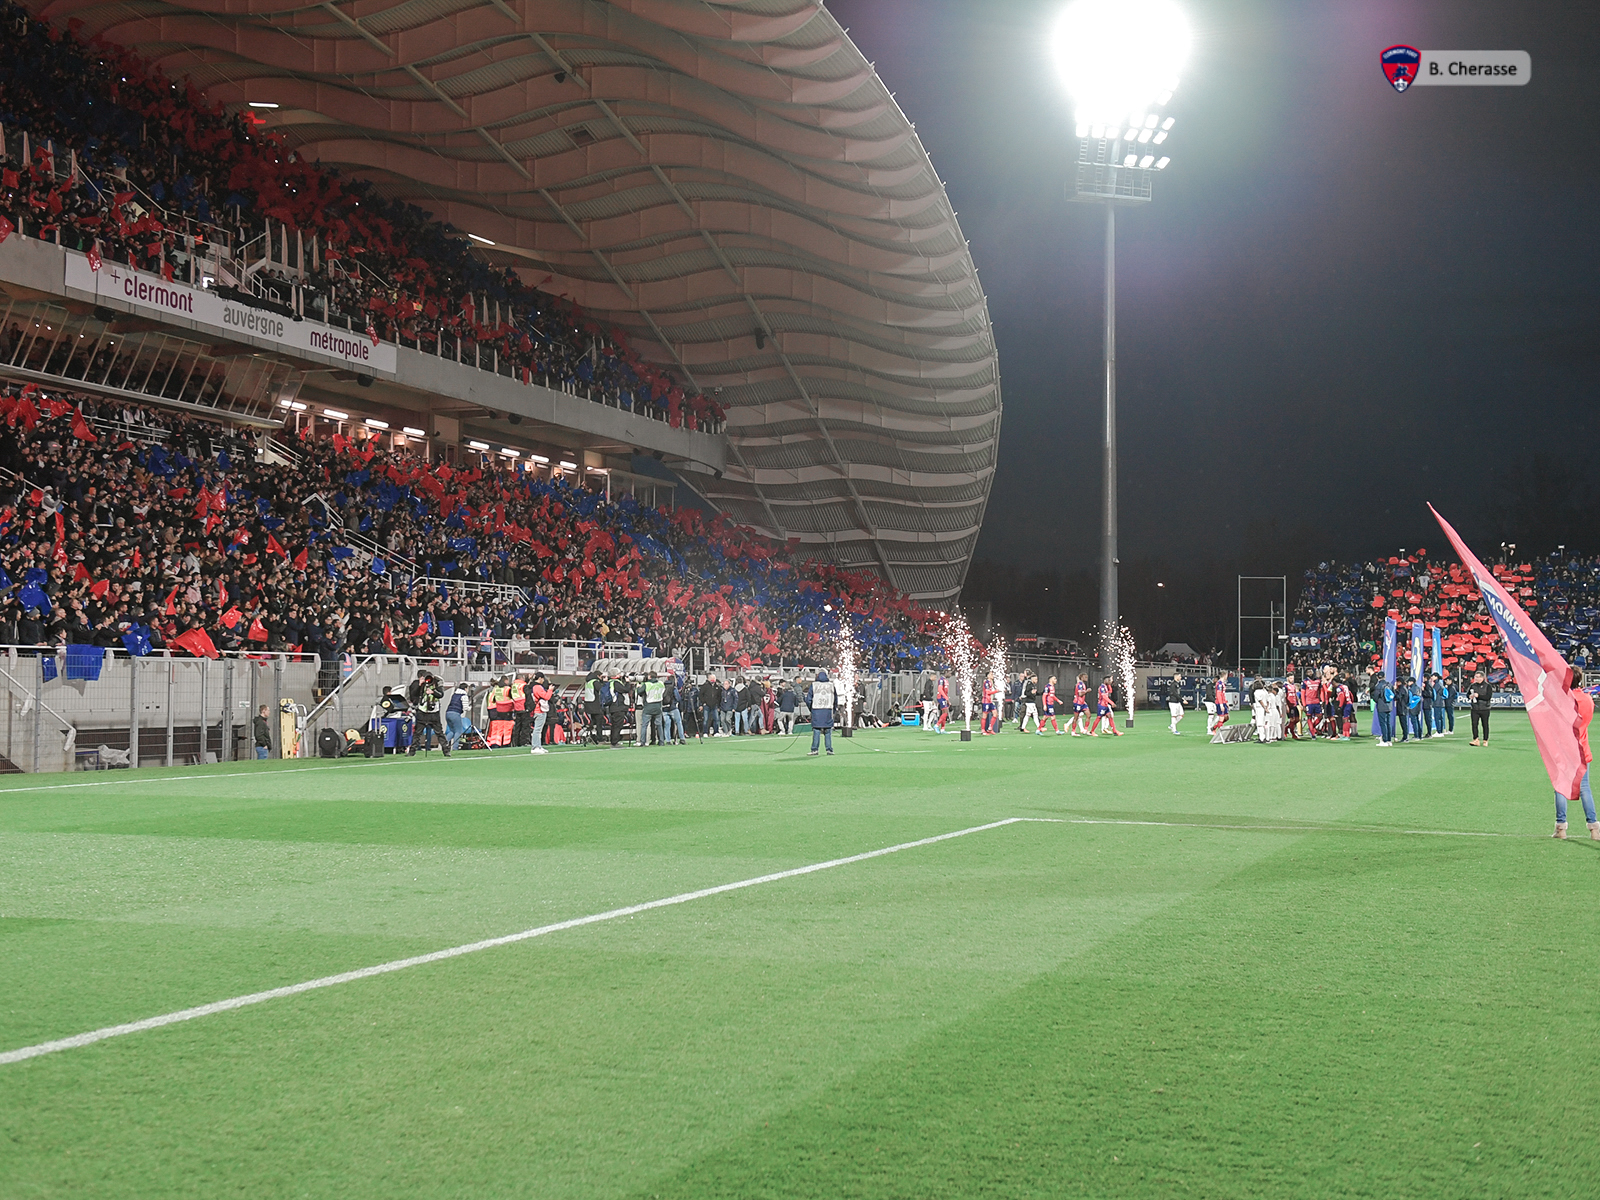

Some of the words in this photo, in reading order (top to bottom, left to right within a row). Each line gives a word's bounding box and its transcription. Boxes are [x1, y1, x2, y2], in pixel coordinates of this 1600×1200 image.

[124, 275, 193, 313] clermont
[223, 306, 284, 338] auvergne
[310, 331, 369, 360] métropole
